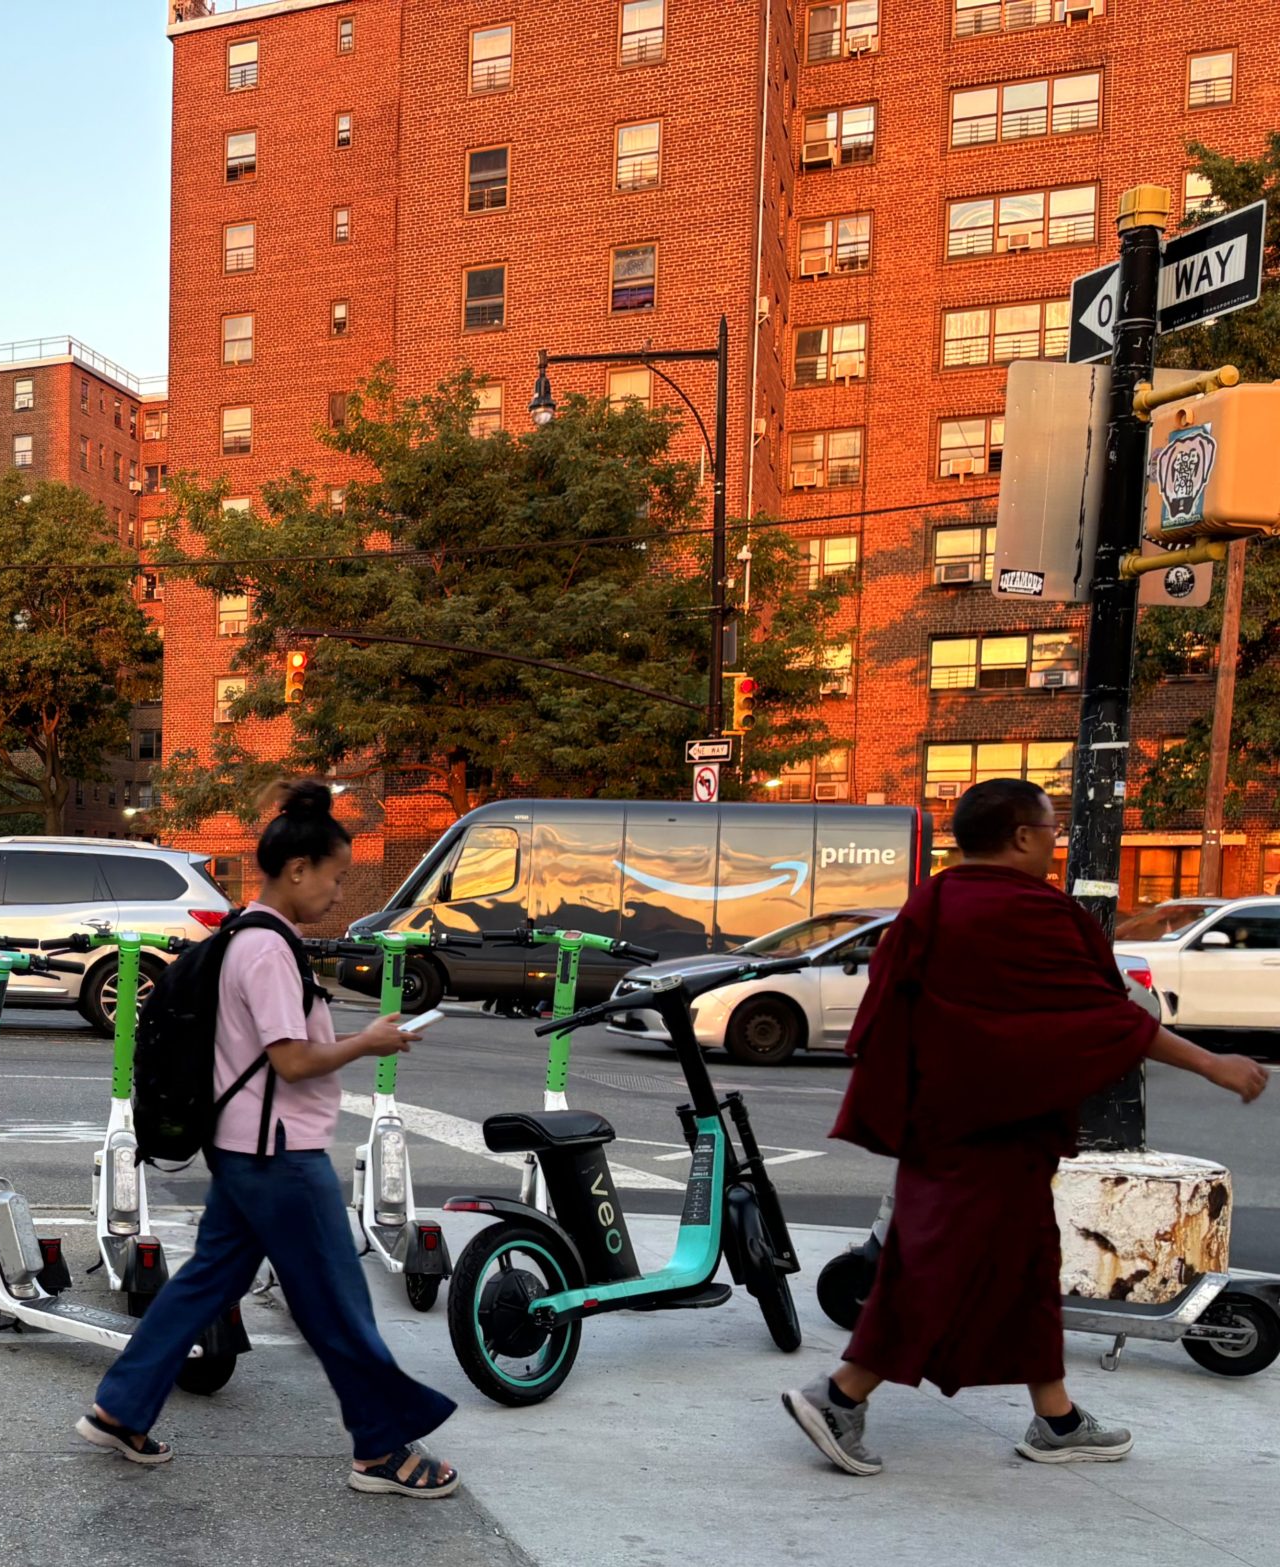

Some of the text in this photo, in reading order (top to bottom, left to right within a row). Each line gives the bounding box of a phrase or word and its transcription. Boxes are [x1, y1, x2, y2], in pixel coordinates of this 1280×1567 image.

[1175, 244, 1235, 300] WAY
[693, 746, 724, 755] ONE WAY
[820, 842, 896, 869] prime
[590, 1172, 623, 1255] veo
